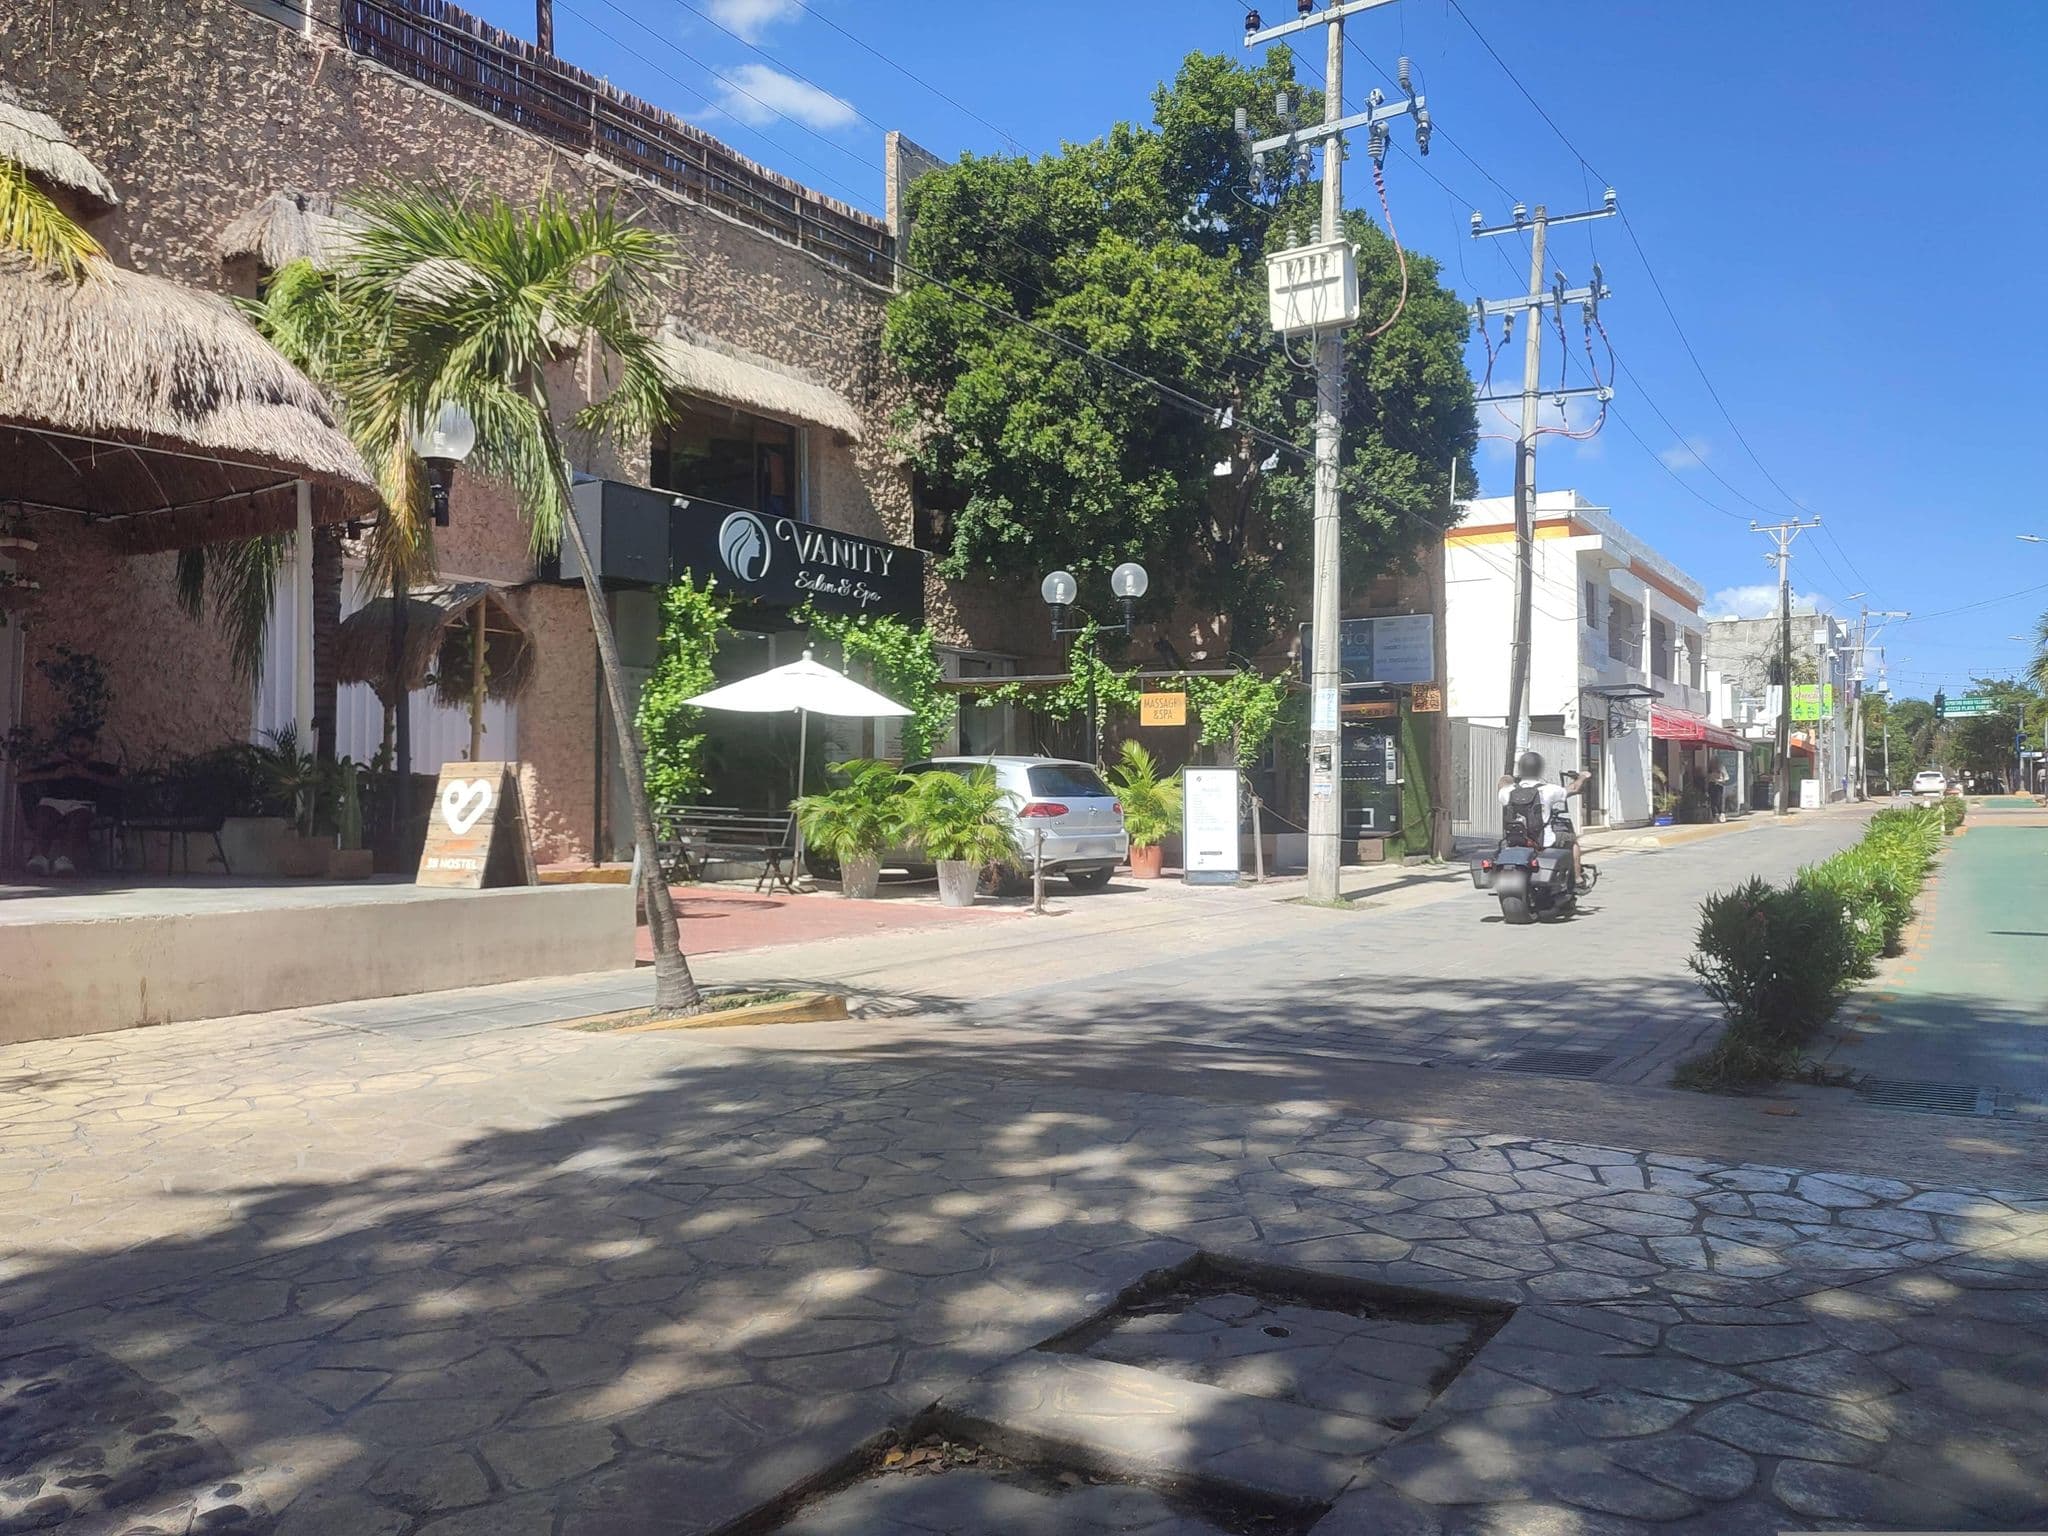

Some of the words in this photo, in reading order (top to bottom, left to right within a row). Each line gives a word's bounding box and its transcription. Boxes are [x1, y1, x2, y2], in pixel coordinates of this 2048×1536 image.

[776, 518, 895, 576] VANITY
[795, 571, 837, 594] Salon
[838, 578, 851, 596] &
[853, 582, 882, 608] Spa
